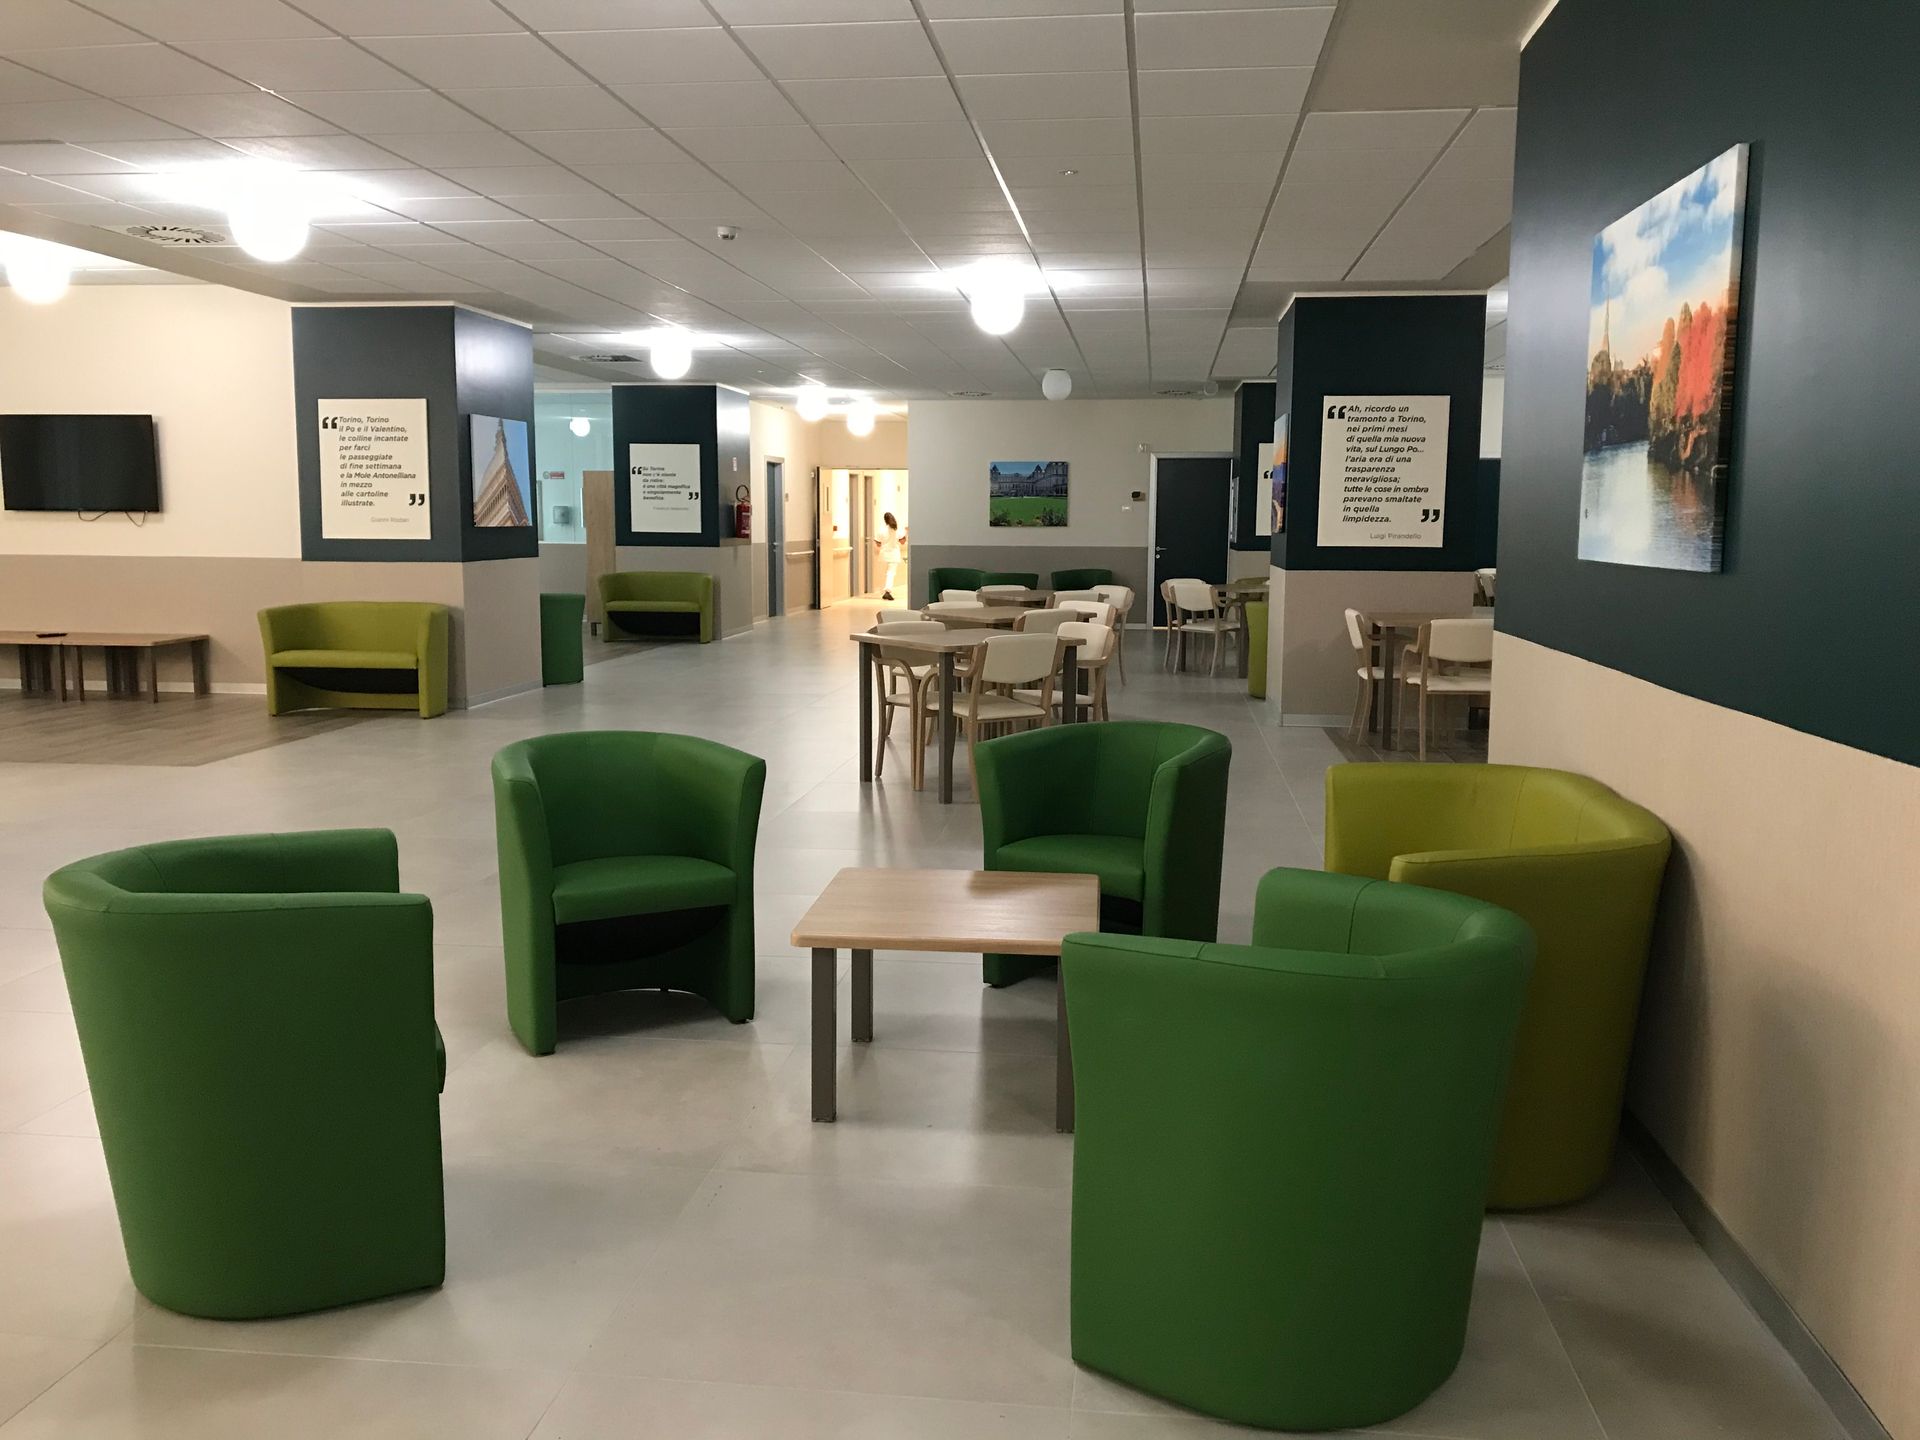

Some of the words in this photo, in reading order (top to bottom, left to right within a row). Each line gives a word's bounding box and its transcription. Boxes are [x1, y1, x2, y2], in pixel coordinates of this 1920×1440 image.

[1348, 405, 1362, 413] Ah,
[1364, 405, 1396, 413] ricordo
[339, 416, 364, 424] Torino,
[1347, 415, 1387, 423] tramonto
[1398, 415, 1427, 423] Torino,
[1362, 425, 1385, 433] primi
[1346, 435, 1355, 443] di
[1356, 435, 1382, 444] quella
[1383, 435, 1399, 443] mia
[1346, 445, 1363, 453] vita,
[1365, 445, 1378, 453] sul
[1379, 445, 1405, 454] Lungo
[348, 454, 393, 462] passeggiate
[1345, 455, 1367, 463] l'aria
[1385, 455, 1394, 463] di
[1345, 465, 1396, 473] trasparenza
[1344, 476, 1401, 484] meravigliosa;
[1344, 485, 1363, 493] tutte
[1364, 485, 1372, 493] le
[1393, 485, 1401, 493] in
[1402, 485, 1429, 493] ombra
[1385, 495, 1422, 503] smaltate
[1353, 505, 1380, 514] quella
[1342, 515, 1392, 523] limpidezza.
